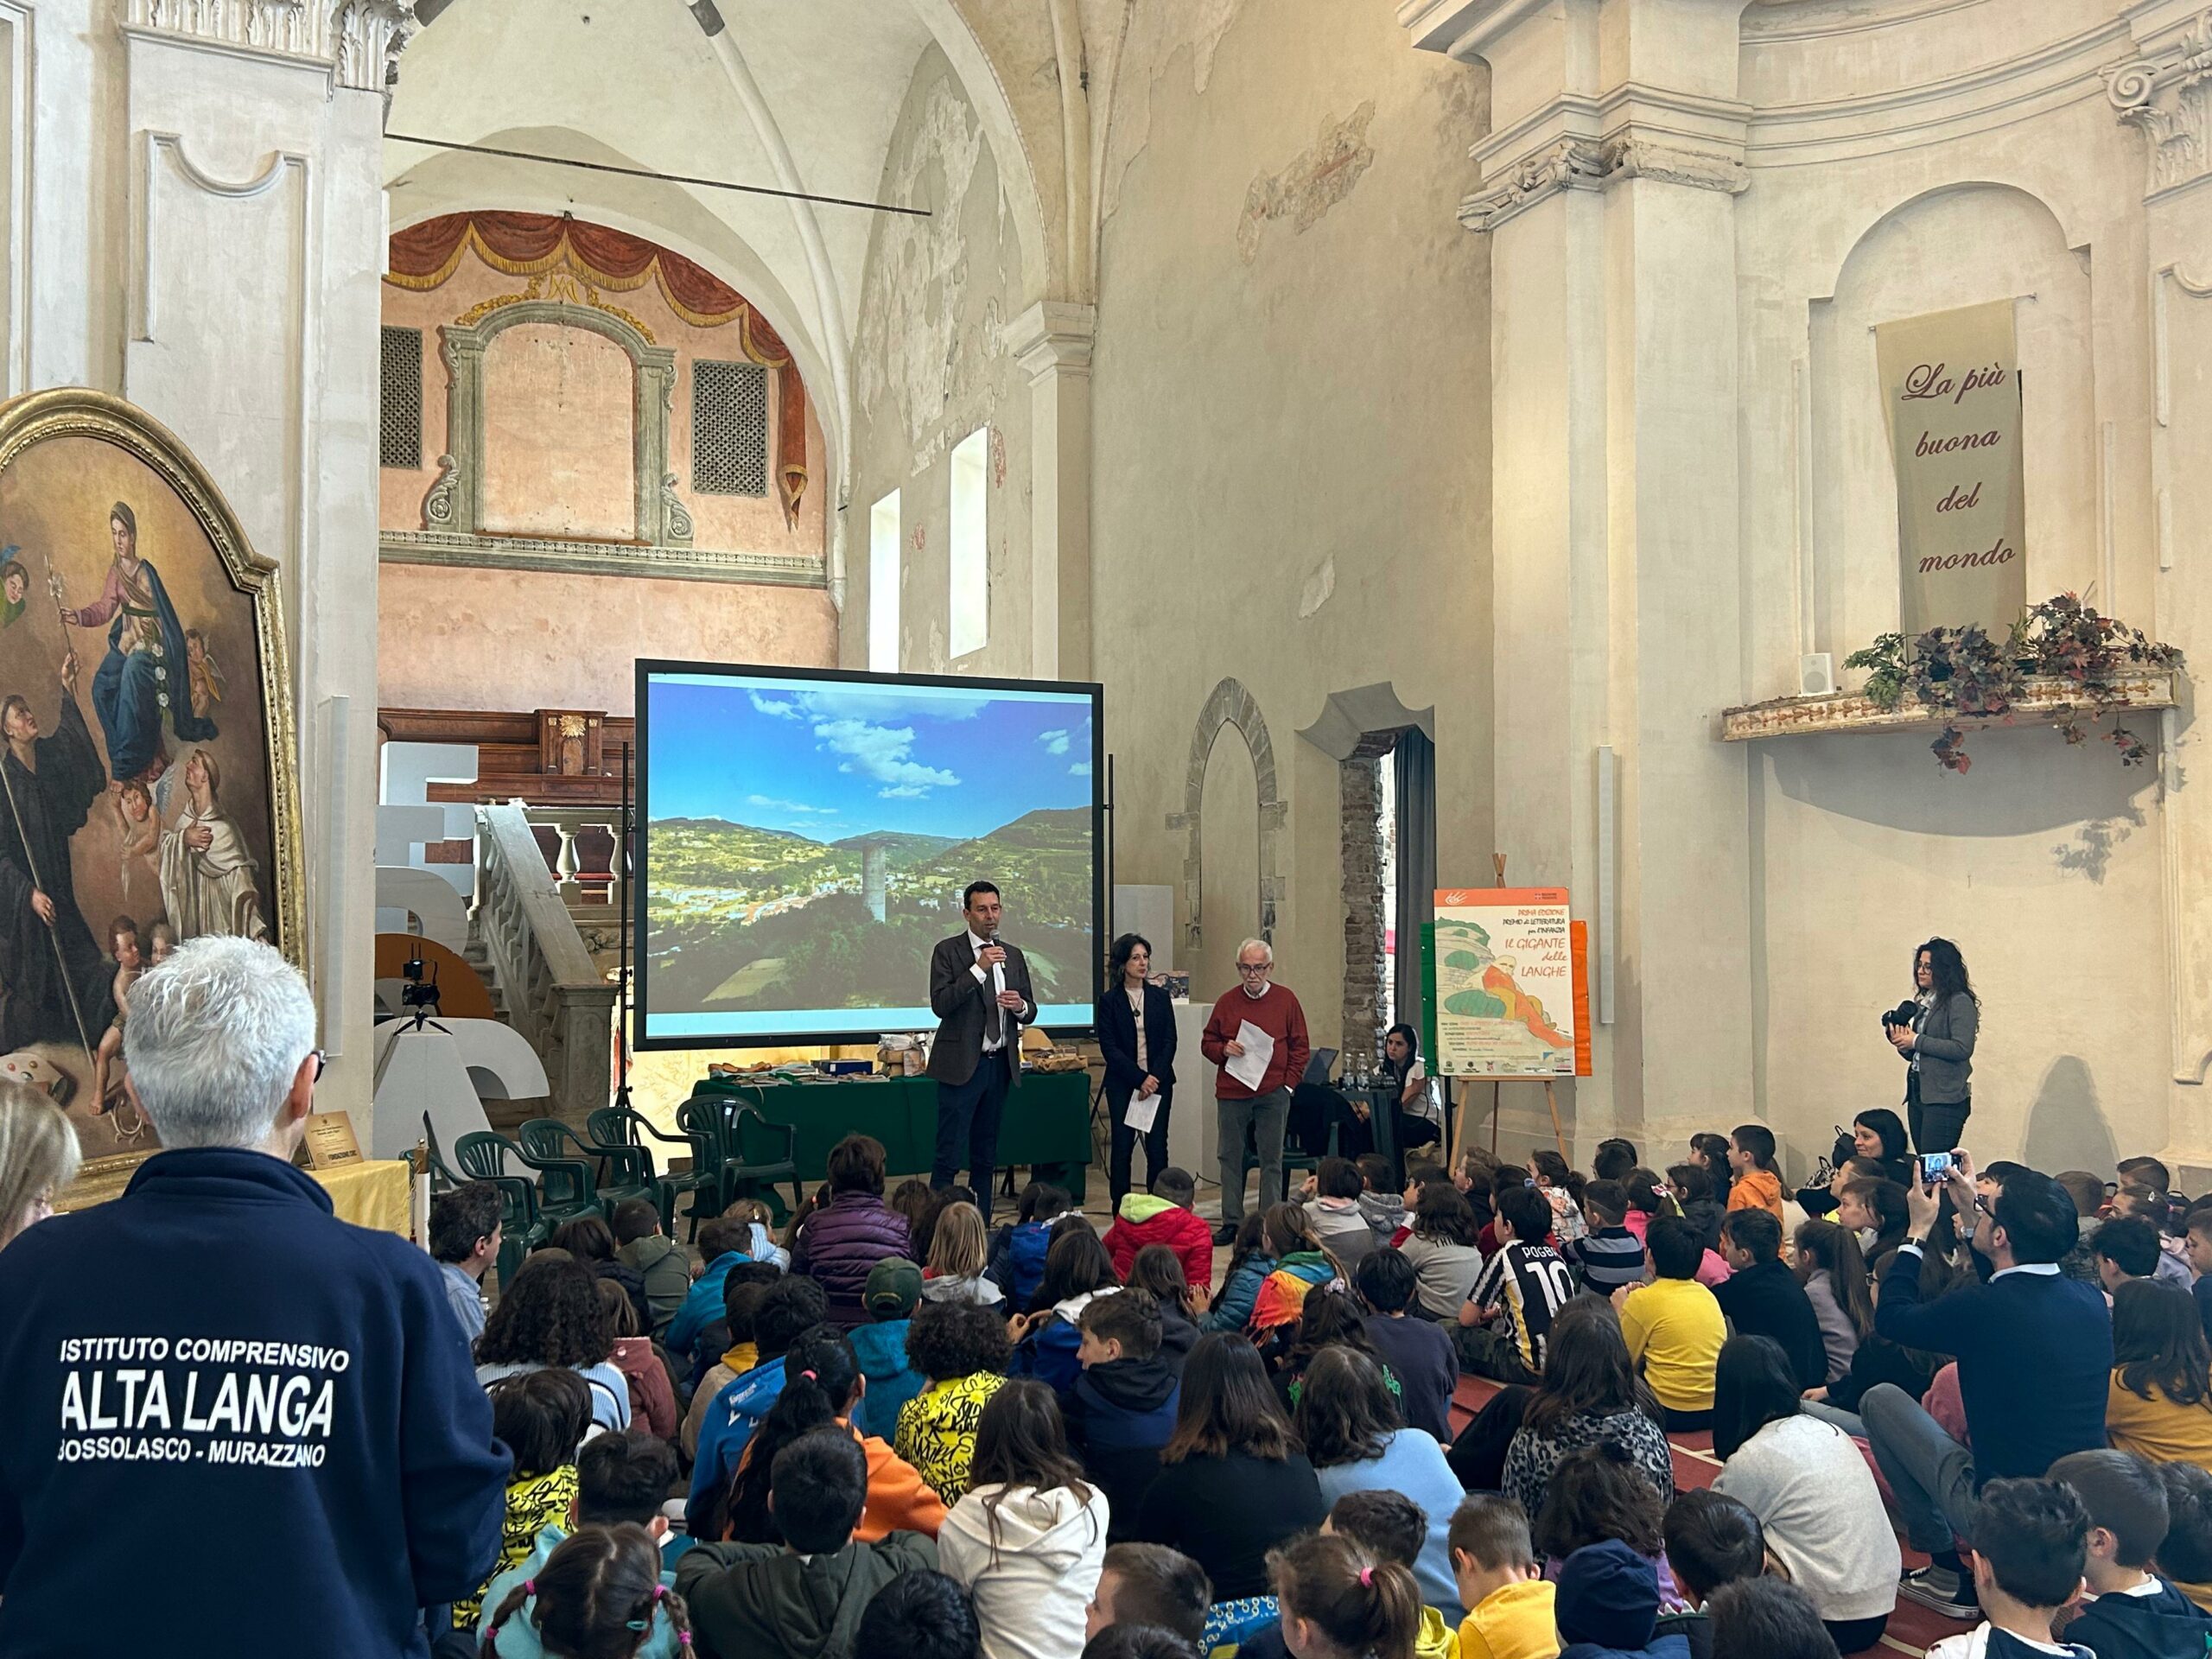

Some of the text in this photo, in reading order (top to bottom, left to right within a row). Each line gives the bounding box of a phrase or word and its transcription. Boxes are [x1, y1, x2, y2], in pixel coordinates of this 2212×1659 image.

[1900, 361, 2006, 404] La più
[1915, 430, 2001, 458] buona
[1936, 481, 1983, 513] del
[1918, 537, 2017, 574] mondo
[1516, 938, 1566, 950] GIGANTE
[1541, 950, 1567, 962] delle
[1521, 966, 1567, 978] LANGHE
[1524, 1260, 1575, 1319] 10
[60, 1338, 349, 1372] ISTITUTO COMPRENSIVO
[61, 1370, 334, 1437] ALTA LANGA
[208, 1440, 326, 1467] MURAZZANO
